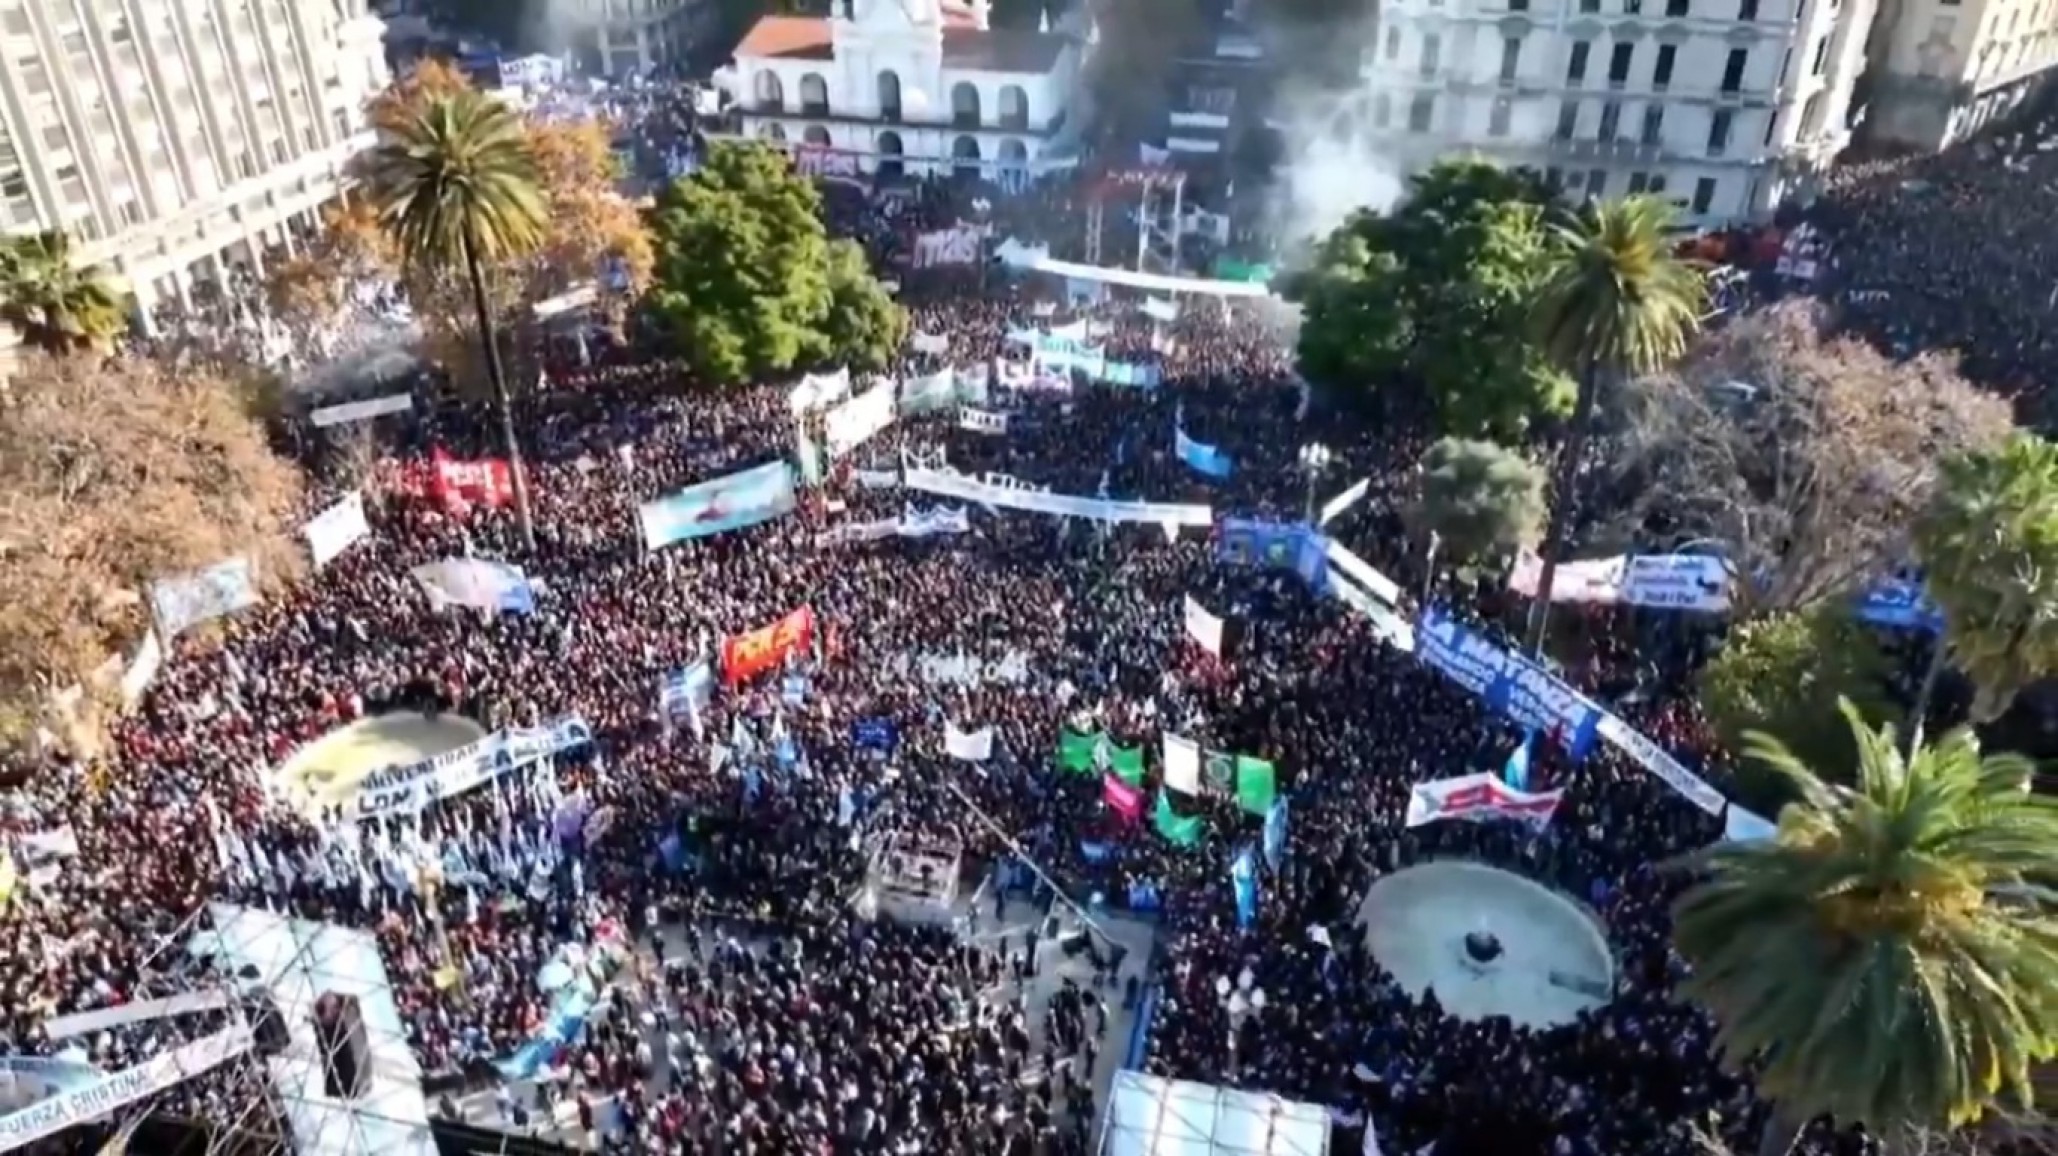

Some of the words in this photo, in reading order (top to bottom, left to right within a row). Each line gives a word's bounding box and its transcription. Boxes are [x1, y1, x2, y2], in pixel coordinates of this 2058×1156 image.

[1422, 608, 1456, 645] LA
[1459, 632, 1589, 727] MATANZA
[70, 1069, 147, 1113] CRISTINA
